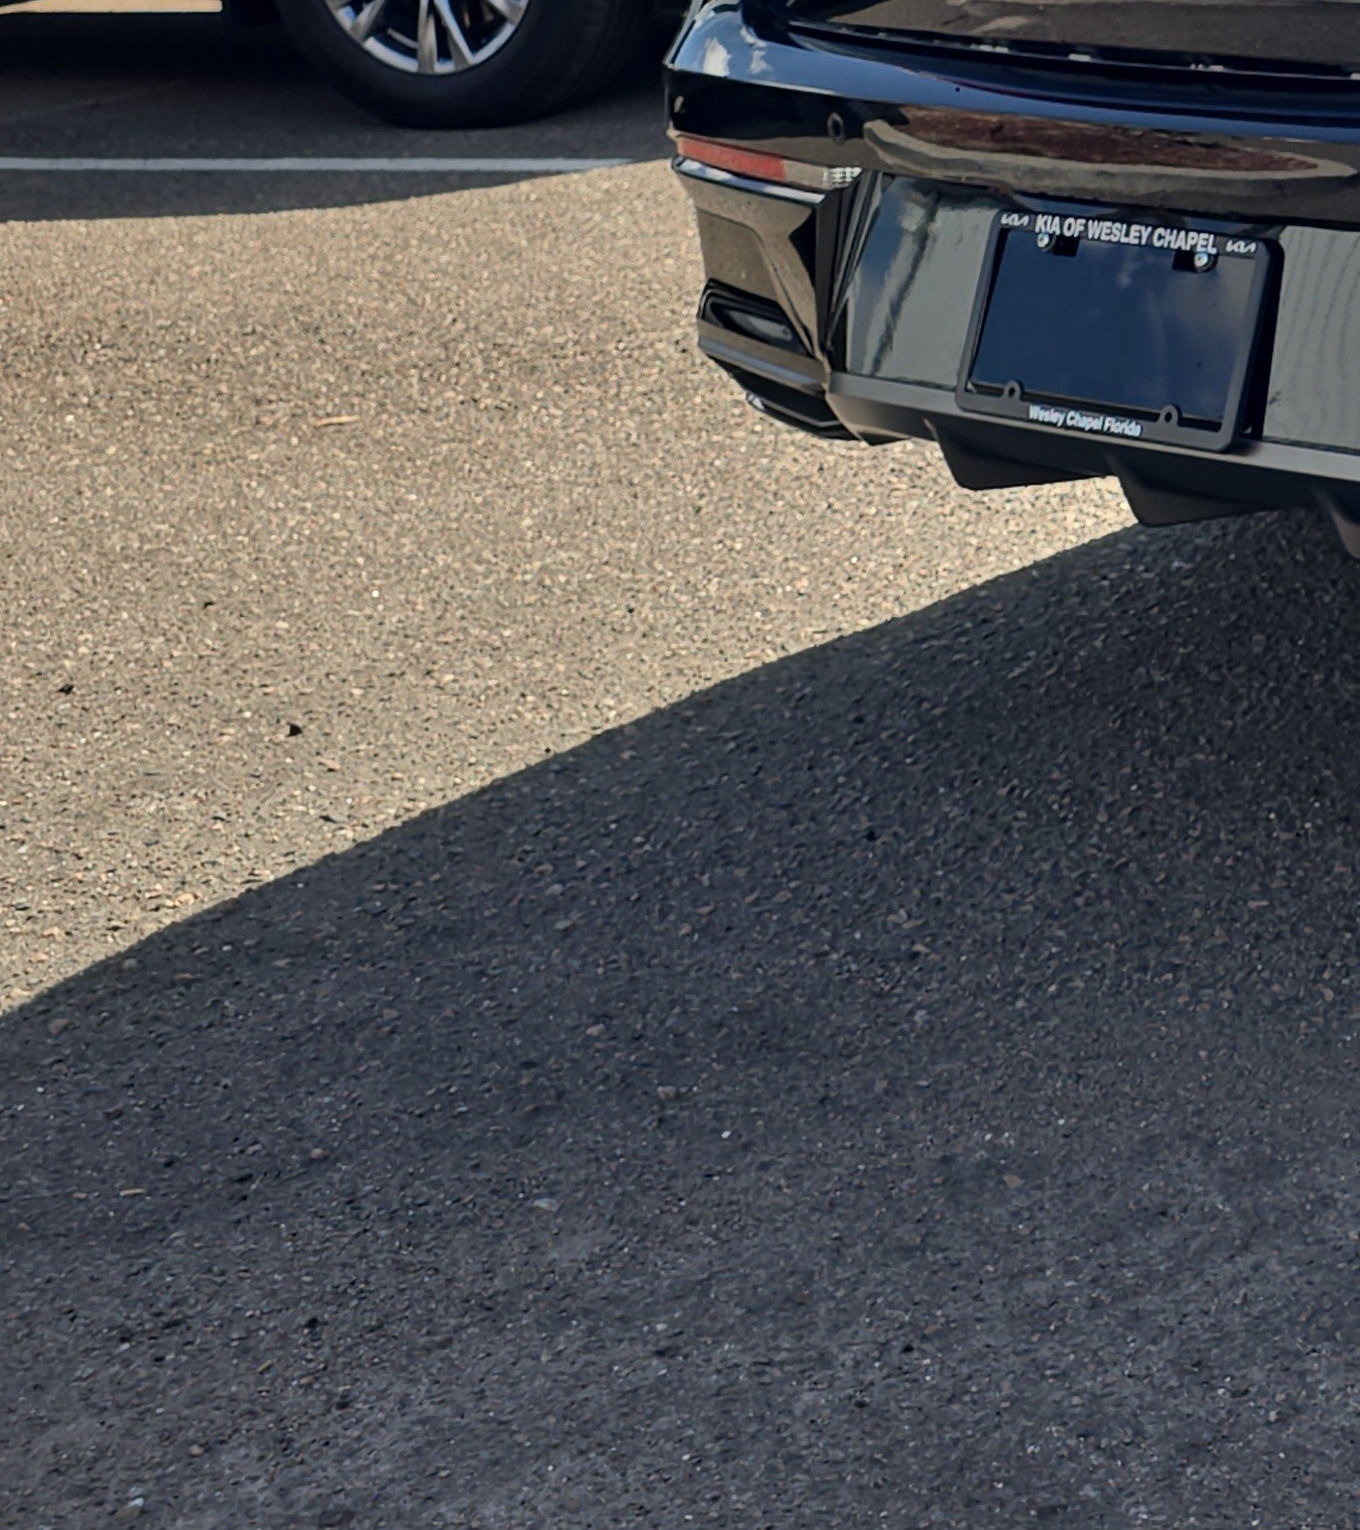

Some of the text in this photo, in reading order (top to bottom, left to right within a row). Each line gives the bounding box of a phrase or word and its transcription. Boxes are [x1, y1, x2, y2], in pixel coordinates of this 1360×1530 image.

[1035, 214, 1217, 254] KIA OF WESLEY CHAPEL
[1029, 405, 1141, 436] Wesley Chapel Florida
